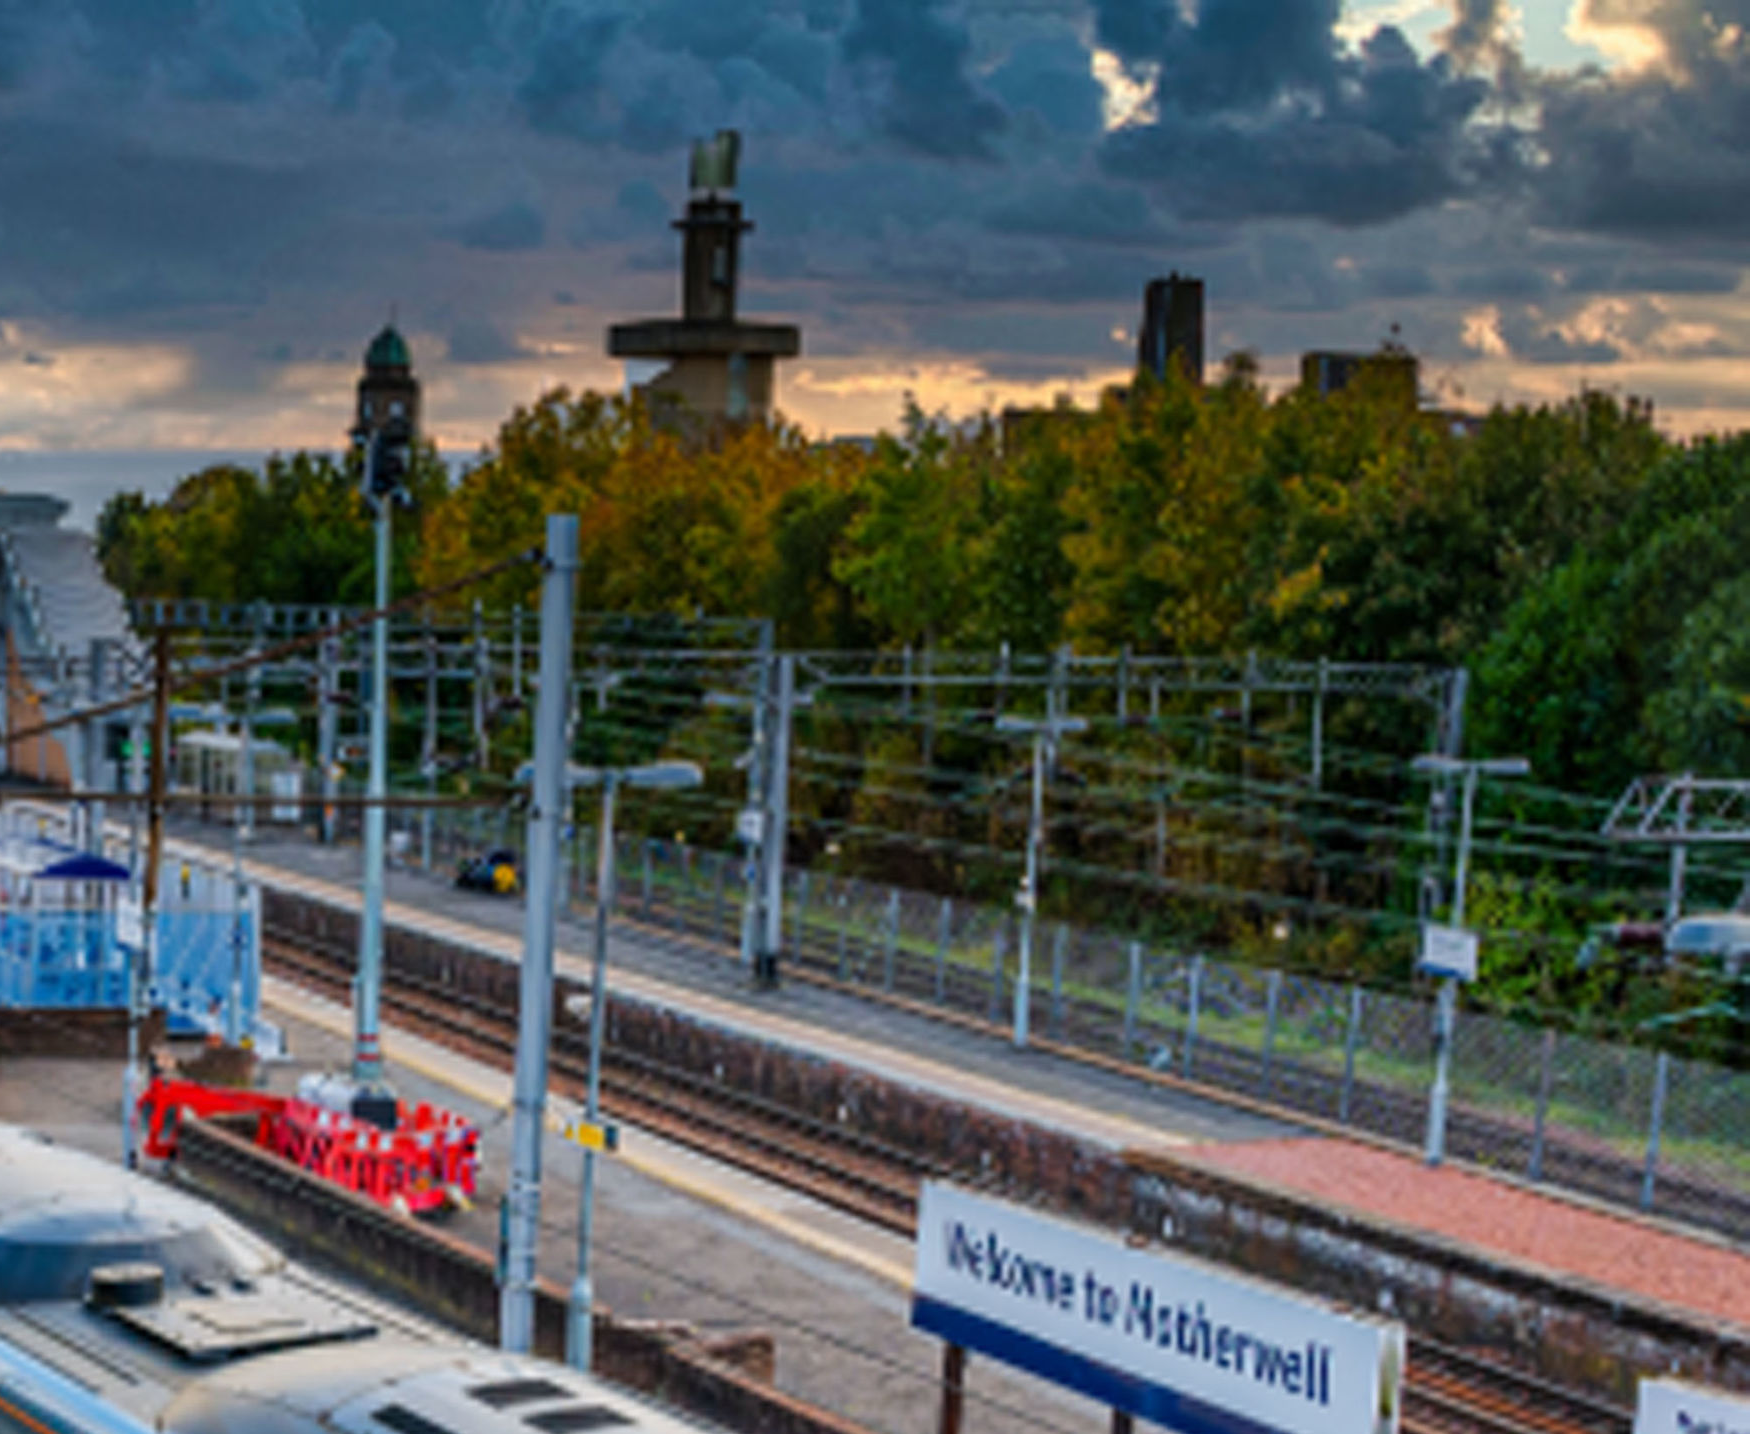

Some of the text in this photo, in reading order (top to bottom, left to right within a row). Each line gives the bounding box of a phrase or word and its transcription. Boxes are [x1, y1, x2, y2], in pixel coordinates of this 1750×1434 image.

[944, 1221, 1331, 1407] Welcome to Motherwell
